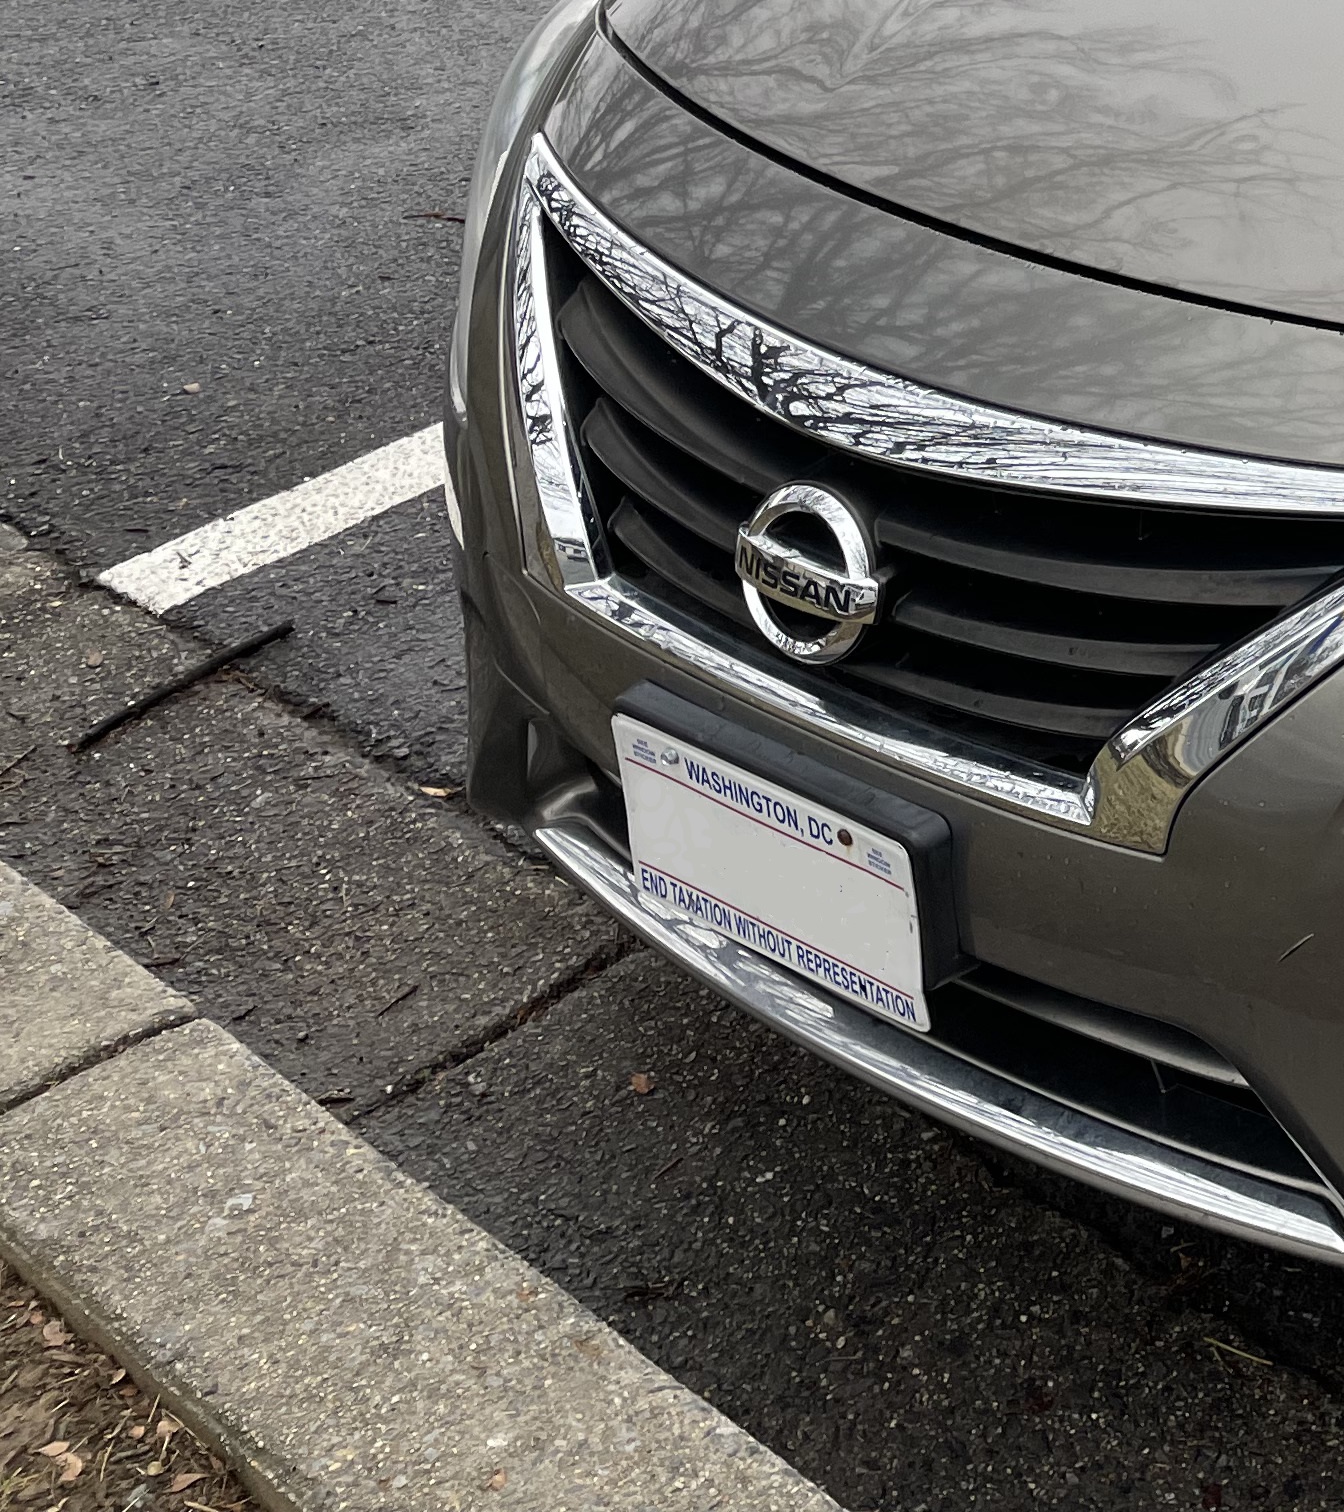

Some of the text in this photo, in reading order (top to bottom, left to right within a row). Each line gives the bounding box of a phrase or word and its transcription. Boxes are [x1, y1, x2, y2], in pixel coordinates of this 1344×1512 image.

[739, 545, 851, 613] NISSAN
[684, 757, 833, 846] WASHINGTON, DC
[641, 867, 917, 1022] END TAXATION WITHOUT REPRESENTATION
